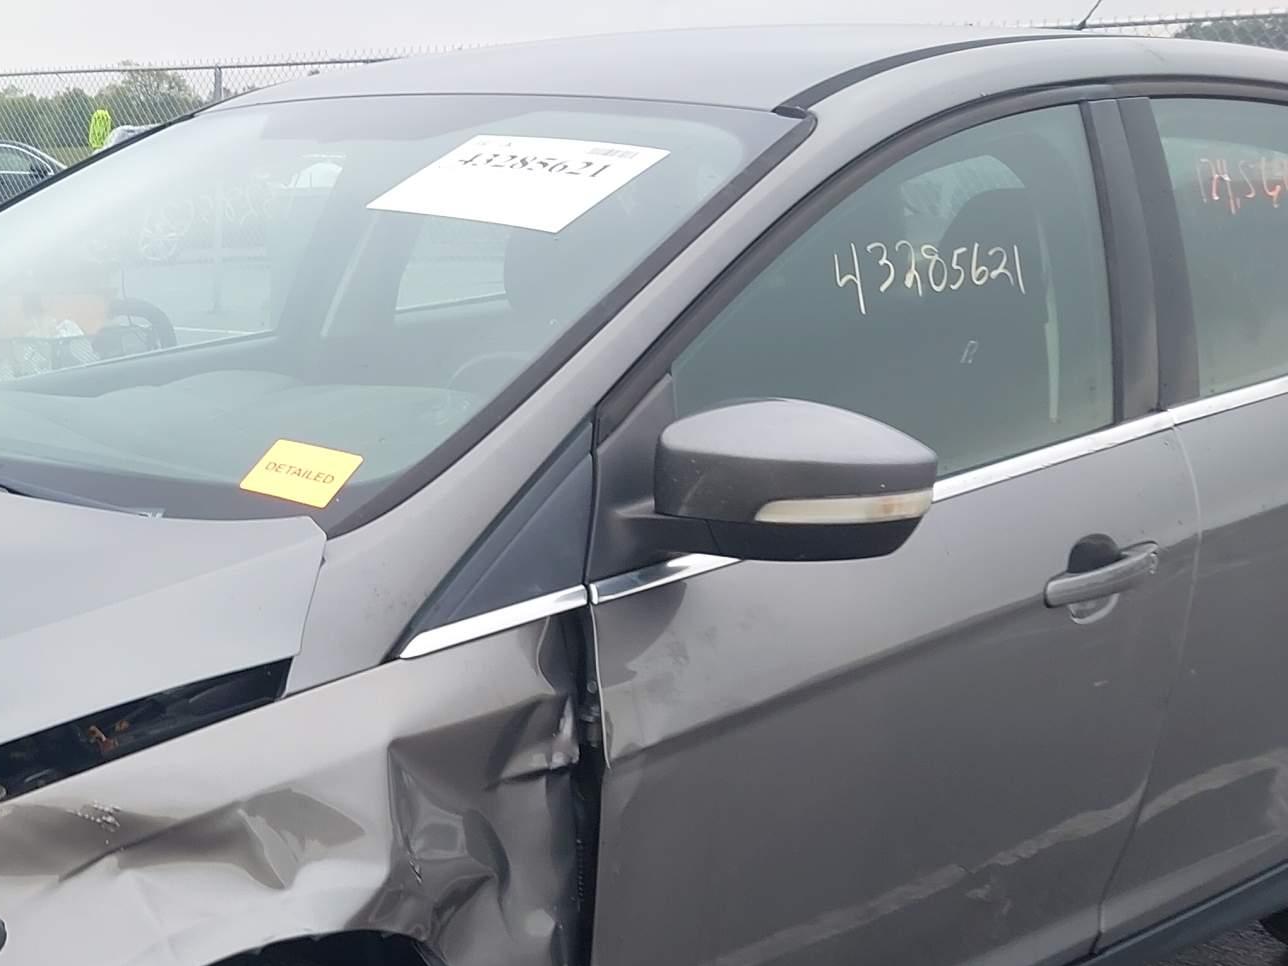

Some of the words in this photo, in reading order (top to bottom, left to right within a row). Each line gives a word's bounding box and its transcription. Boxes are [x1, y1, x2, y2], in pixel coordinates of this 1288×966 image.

[457, 152, 612, 178] 43285621
[833, 239, 1027, 315] 43285621
[264, 461, 335, 484] DETAILED
